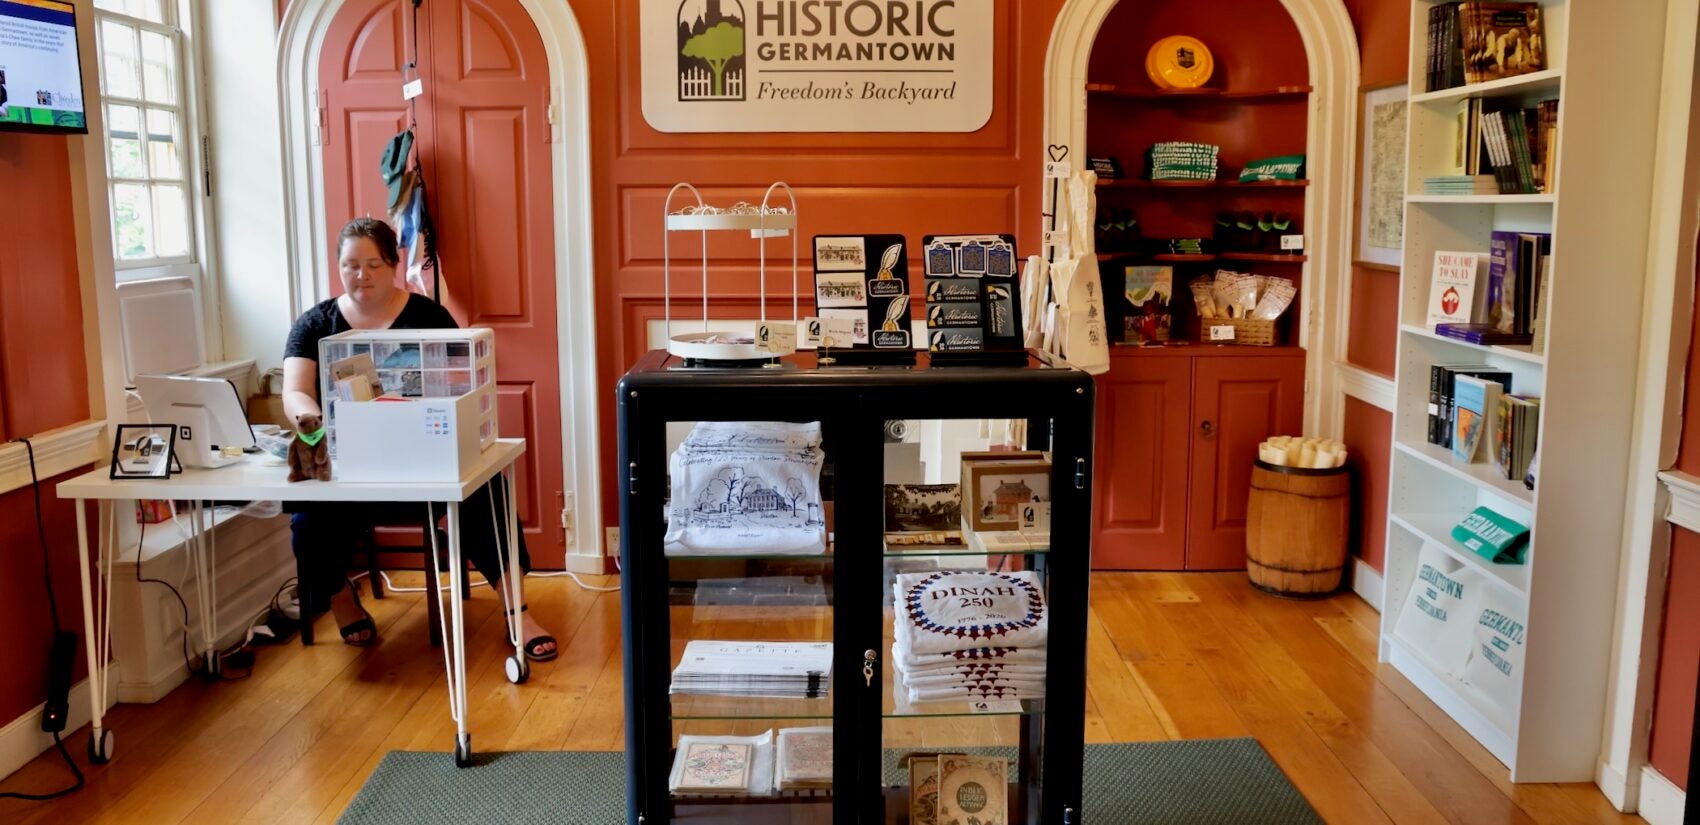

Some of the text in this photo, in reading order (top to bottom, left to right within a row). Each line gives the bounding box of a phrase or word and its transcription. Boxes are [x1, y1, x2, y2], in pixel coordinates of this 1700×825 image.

[756, 0, 956, 37] HISTORIC
[757, 42, 956, 62] GERMANTOWN
[756, 81, 957, 105] Freedom's Backyard
[931, 586, 1016, 600] DINAH
[959, 597, 994, 608] 250
[957, 616, 977, 624] 1776
